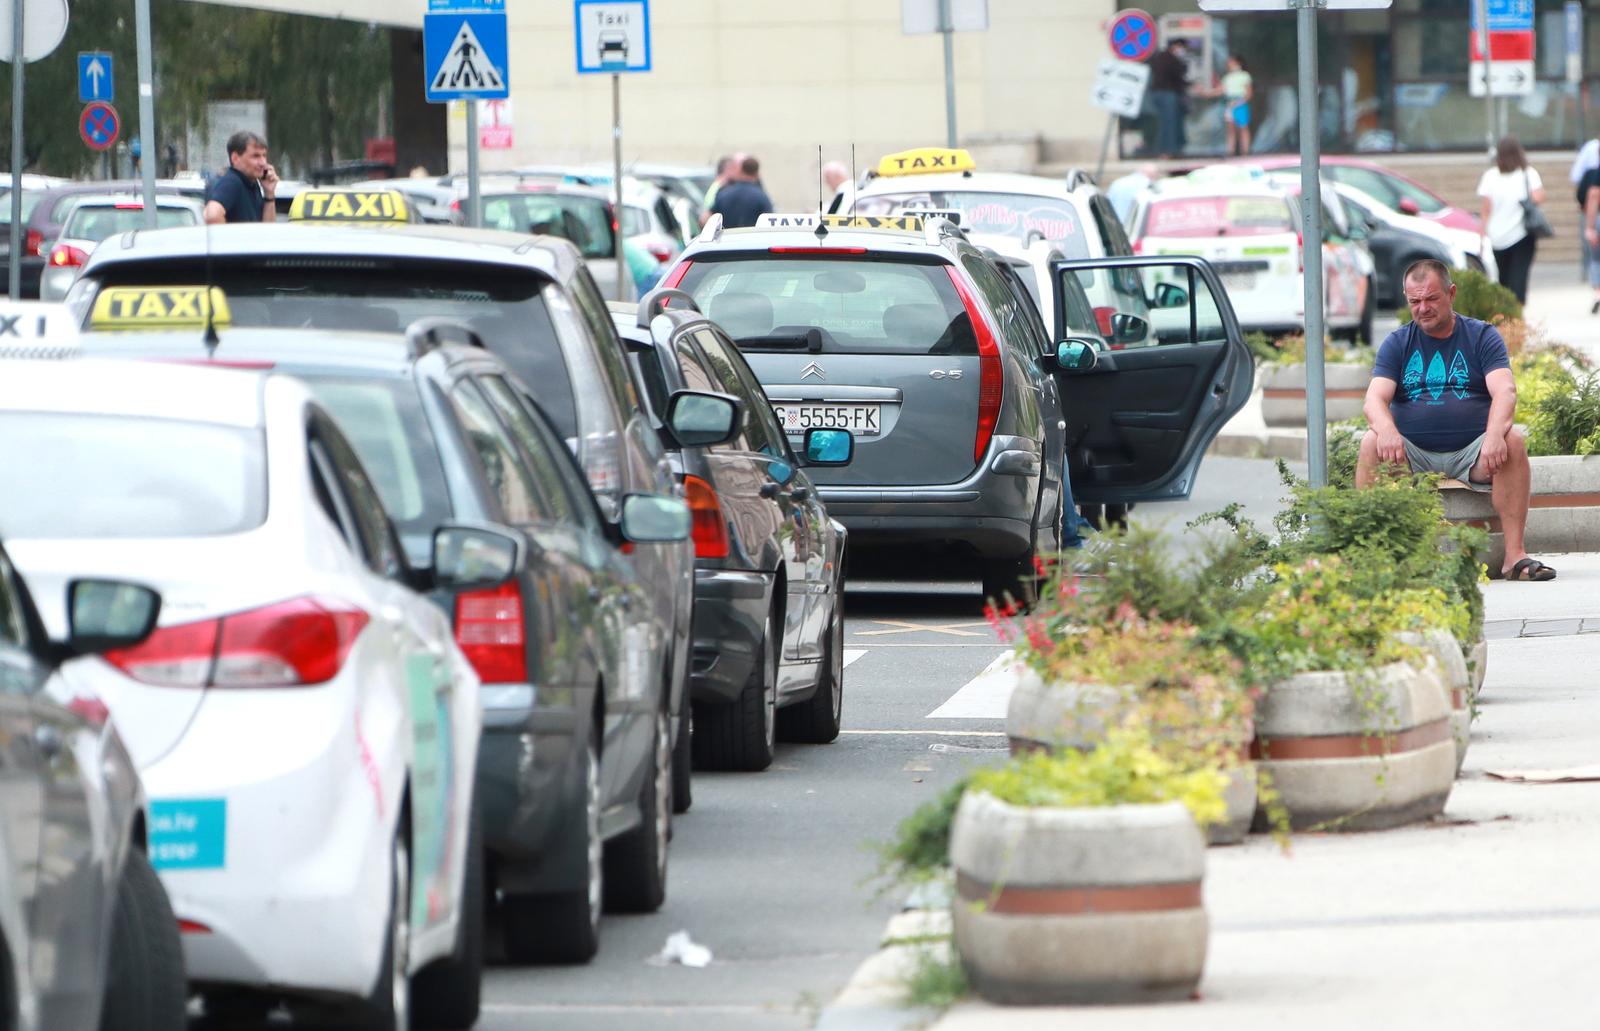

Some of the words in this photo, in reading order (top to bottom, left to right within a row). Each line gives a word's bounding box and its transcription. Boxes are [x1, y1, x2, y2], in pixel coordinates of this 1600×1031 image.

[596, 11, 629, 25] Taxi
[894, 155, 956, 169] TAXI
[305, 193, 394, 217] TAXI
[822, 216, 916, 232] TAXI
[112, 291, 210, 317] TAXI
[928, 369, 963, 380] C5
